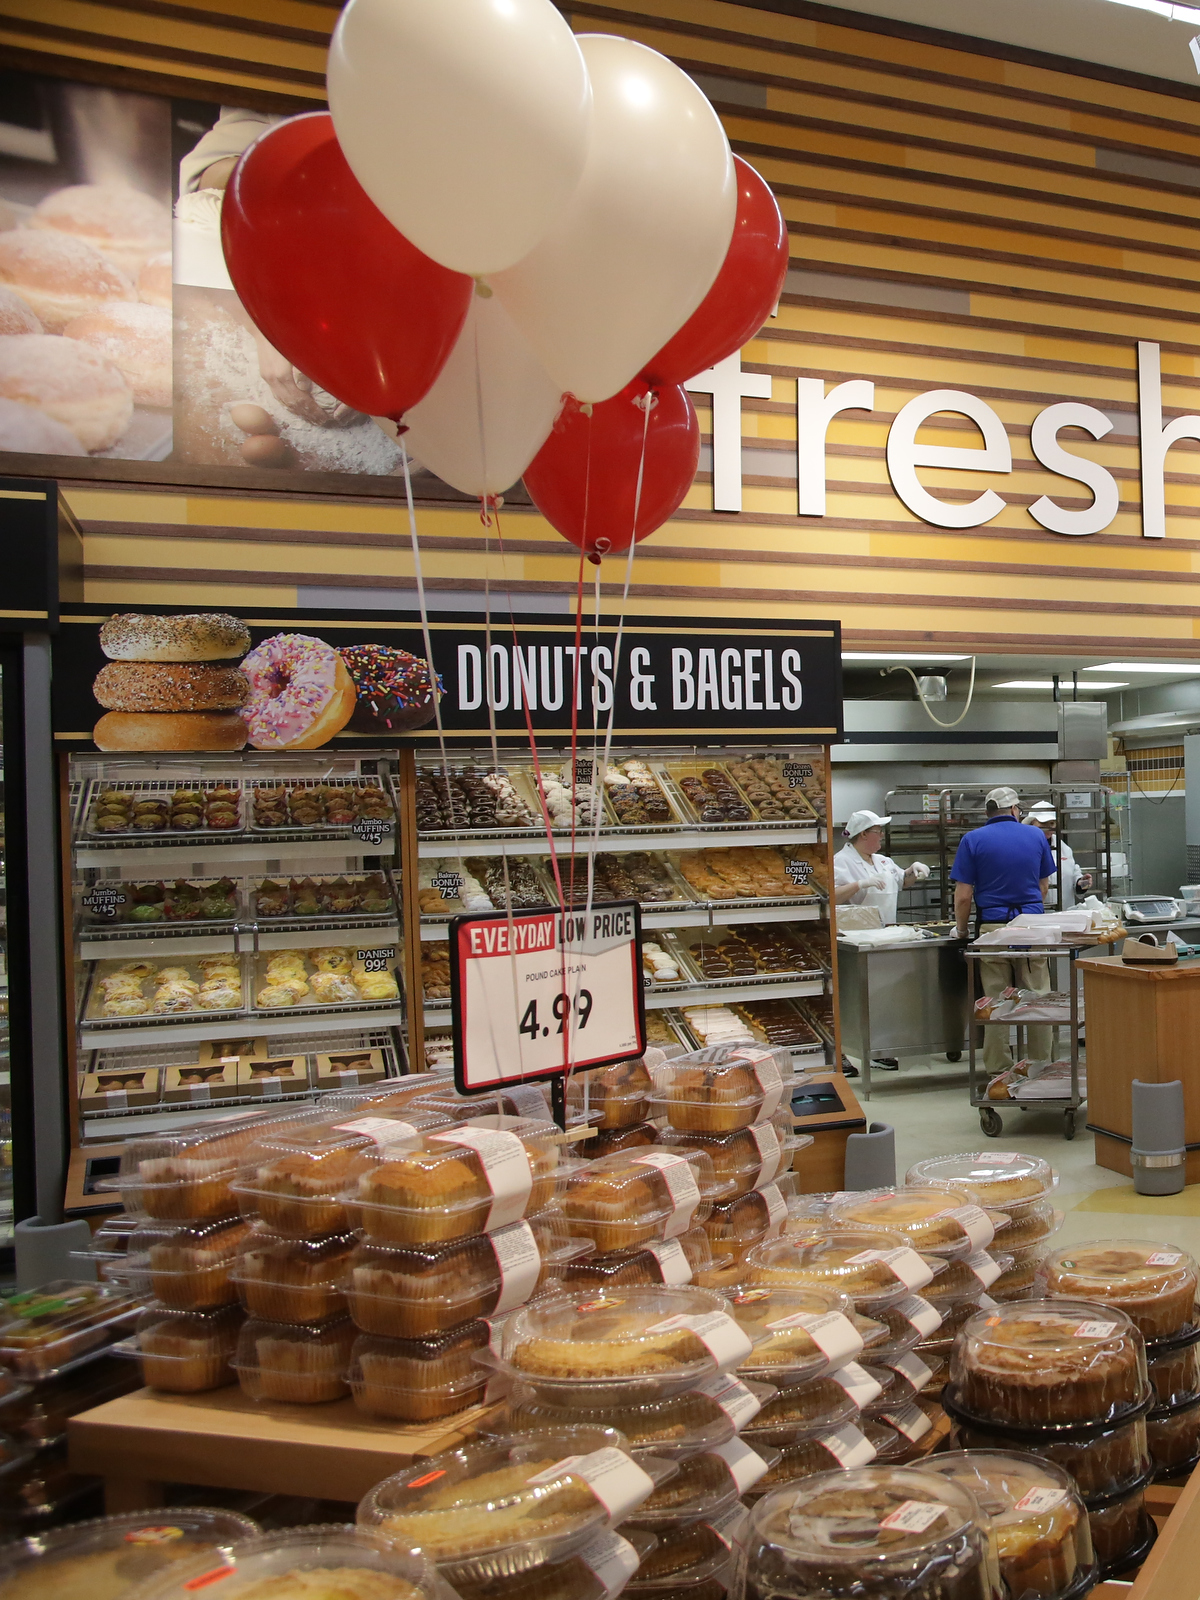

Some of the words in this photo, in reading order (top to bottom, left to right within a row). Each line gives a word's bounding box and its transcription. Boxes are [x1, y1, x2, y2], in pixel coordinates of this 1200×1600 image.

[457, 645, 615, 711] DONUTS
[630, 646, 657, 711] &
[671, 647, 802, 712] BAGELS
[783, 769, 812, 777] DONUTS
[353, 824, 390, 833] MUFFINS
[785, 866, 814, 874] DONUTS
[432, 879, 465, 887] DONUTS
[83, 895, 126, 905] MUFFINS
[470, 920, 553, 954] EVERYDAY
[558, 915, 586, 944] LOW
[593, 911, 632, 939] PRICE
[358, 949, 394, 960] DANISH
[525, 970, 549, 982] POUND
[550, 967, 566, 978] CAKE
[568, 964, 587, 976] PLAN
[519, 988, 593, 1040] 4.99
